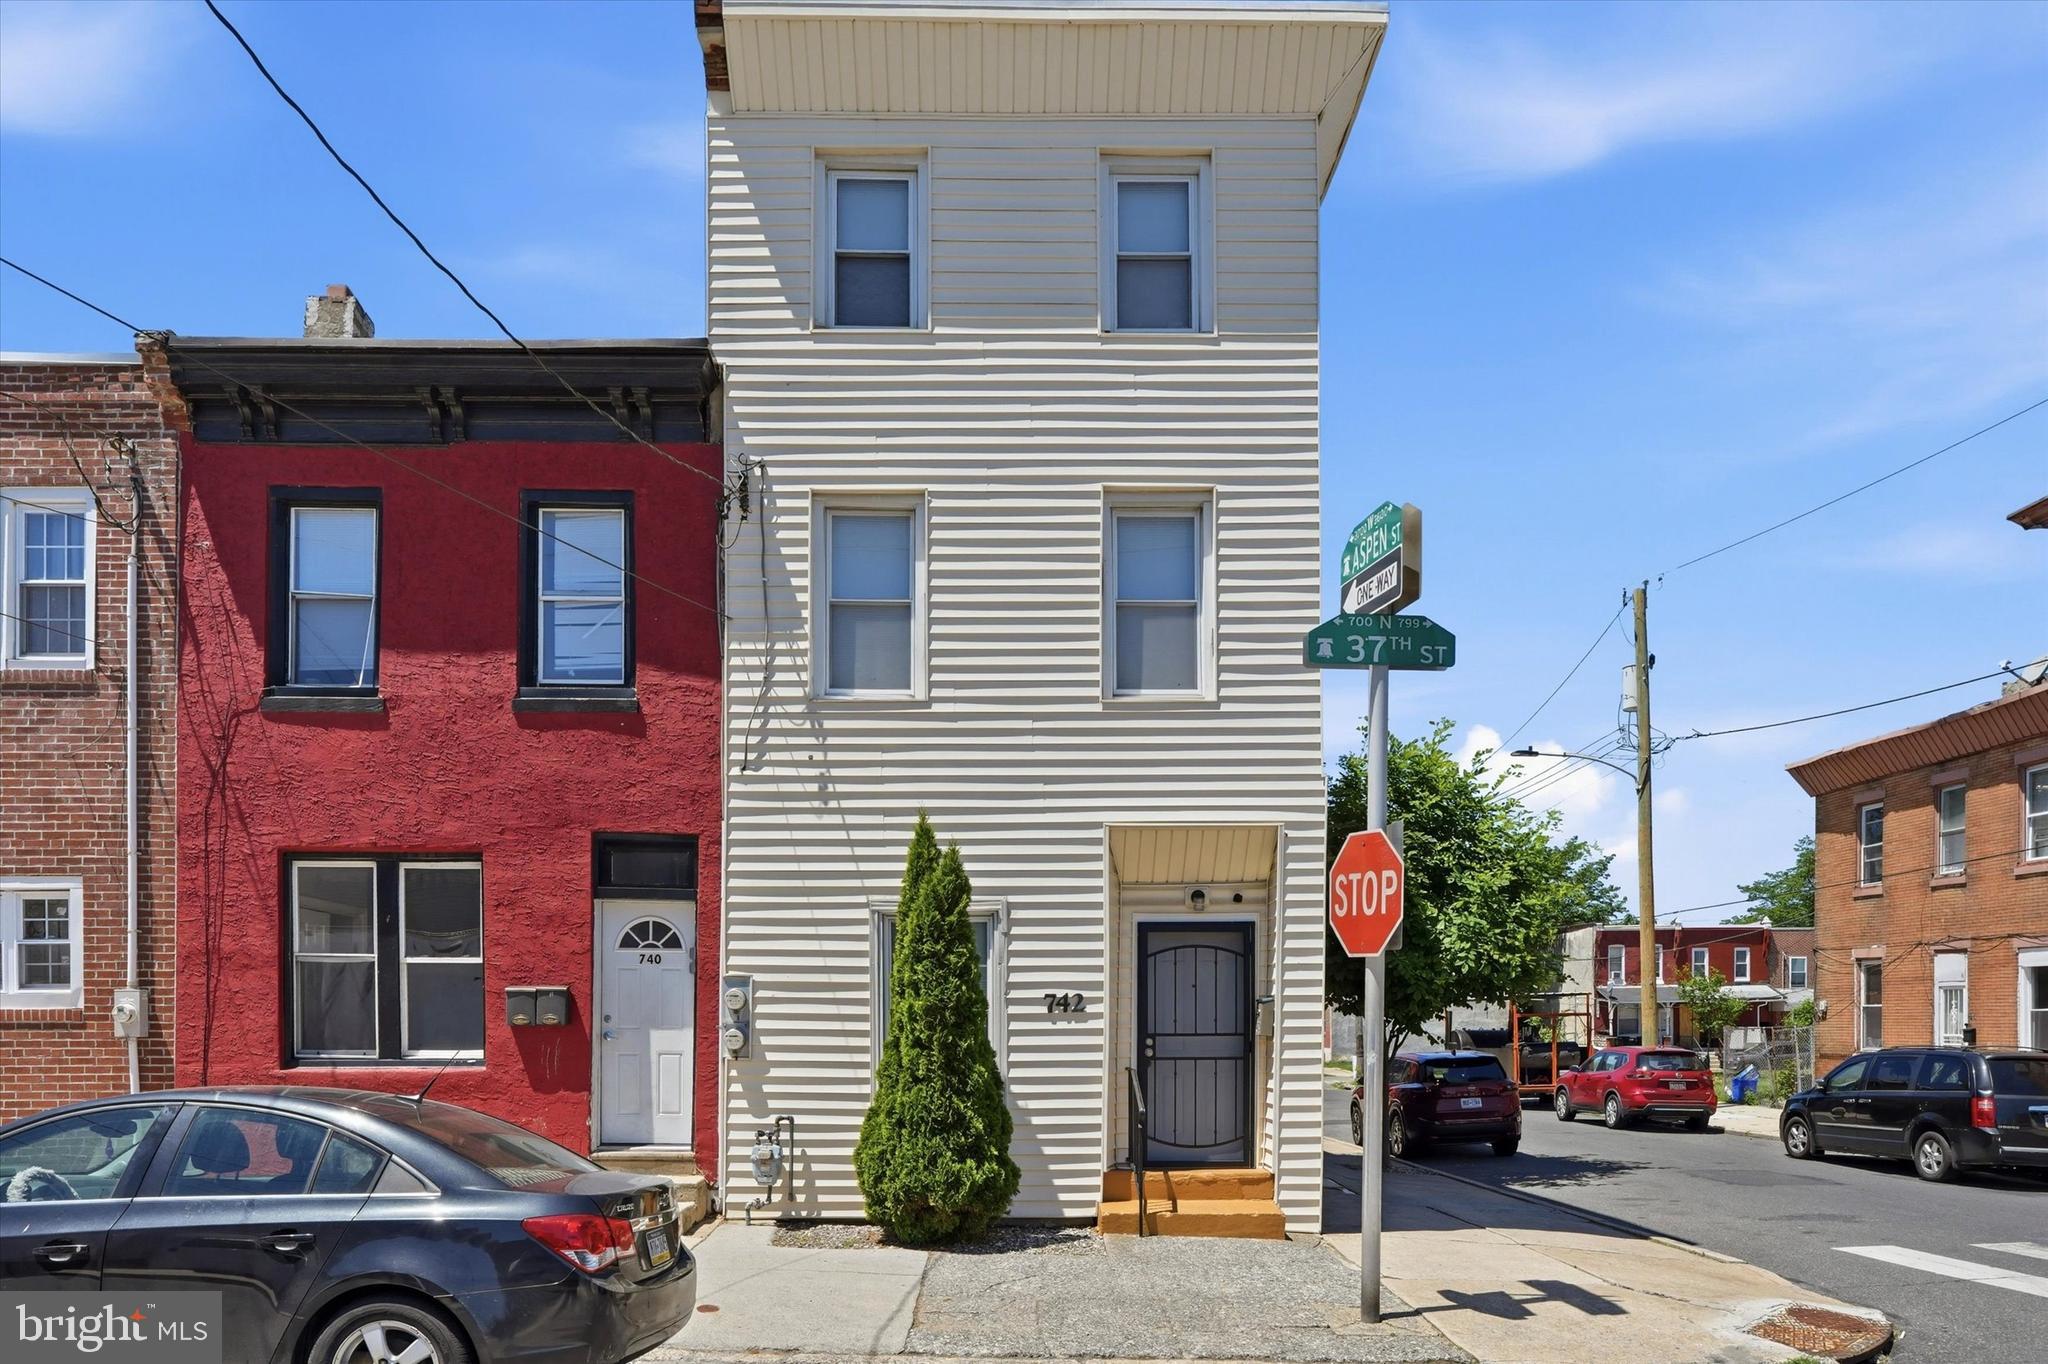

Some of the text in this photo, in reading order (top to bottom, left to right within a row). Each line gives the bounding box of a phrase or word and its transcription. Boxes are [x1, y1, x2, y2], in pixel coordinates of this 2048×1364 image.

[1367, 514, 1375, 531] W
[1352, 521, 1401, 574] ASPEN ST
[1356, 565, 1395, 606] ONE WAY
[1348, 615, 1420, 629] 700 N 799
[1420, 646, 1447, 664] ST
[1334, 869, 1398, 918] STOP
[639, 953, 662, 964] 740
[1043, 992, 1087, 1014] 742
